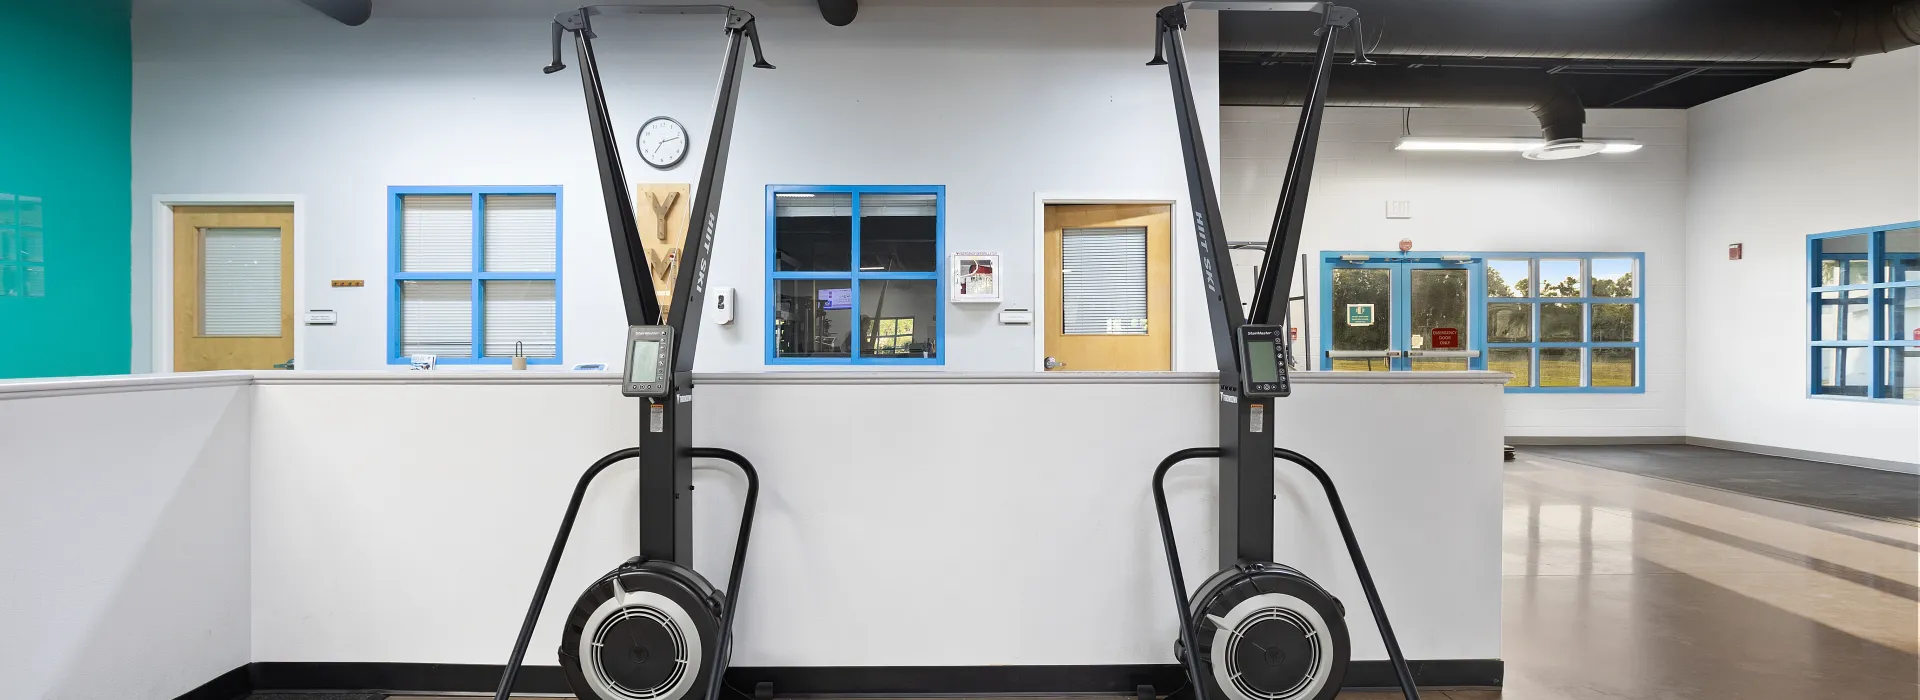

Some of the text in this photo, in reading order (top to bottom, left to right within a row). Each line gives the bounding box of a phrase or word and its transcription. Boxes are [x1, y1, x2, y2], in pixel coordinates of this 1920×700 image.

[696, 212, 715, 293] HIIT SKI
[1195, 211, 1216, 292] HIIT SKI
